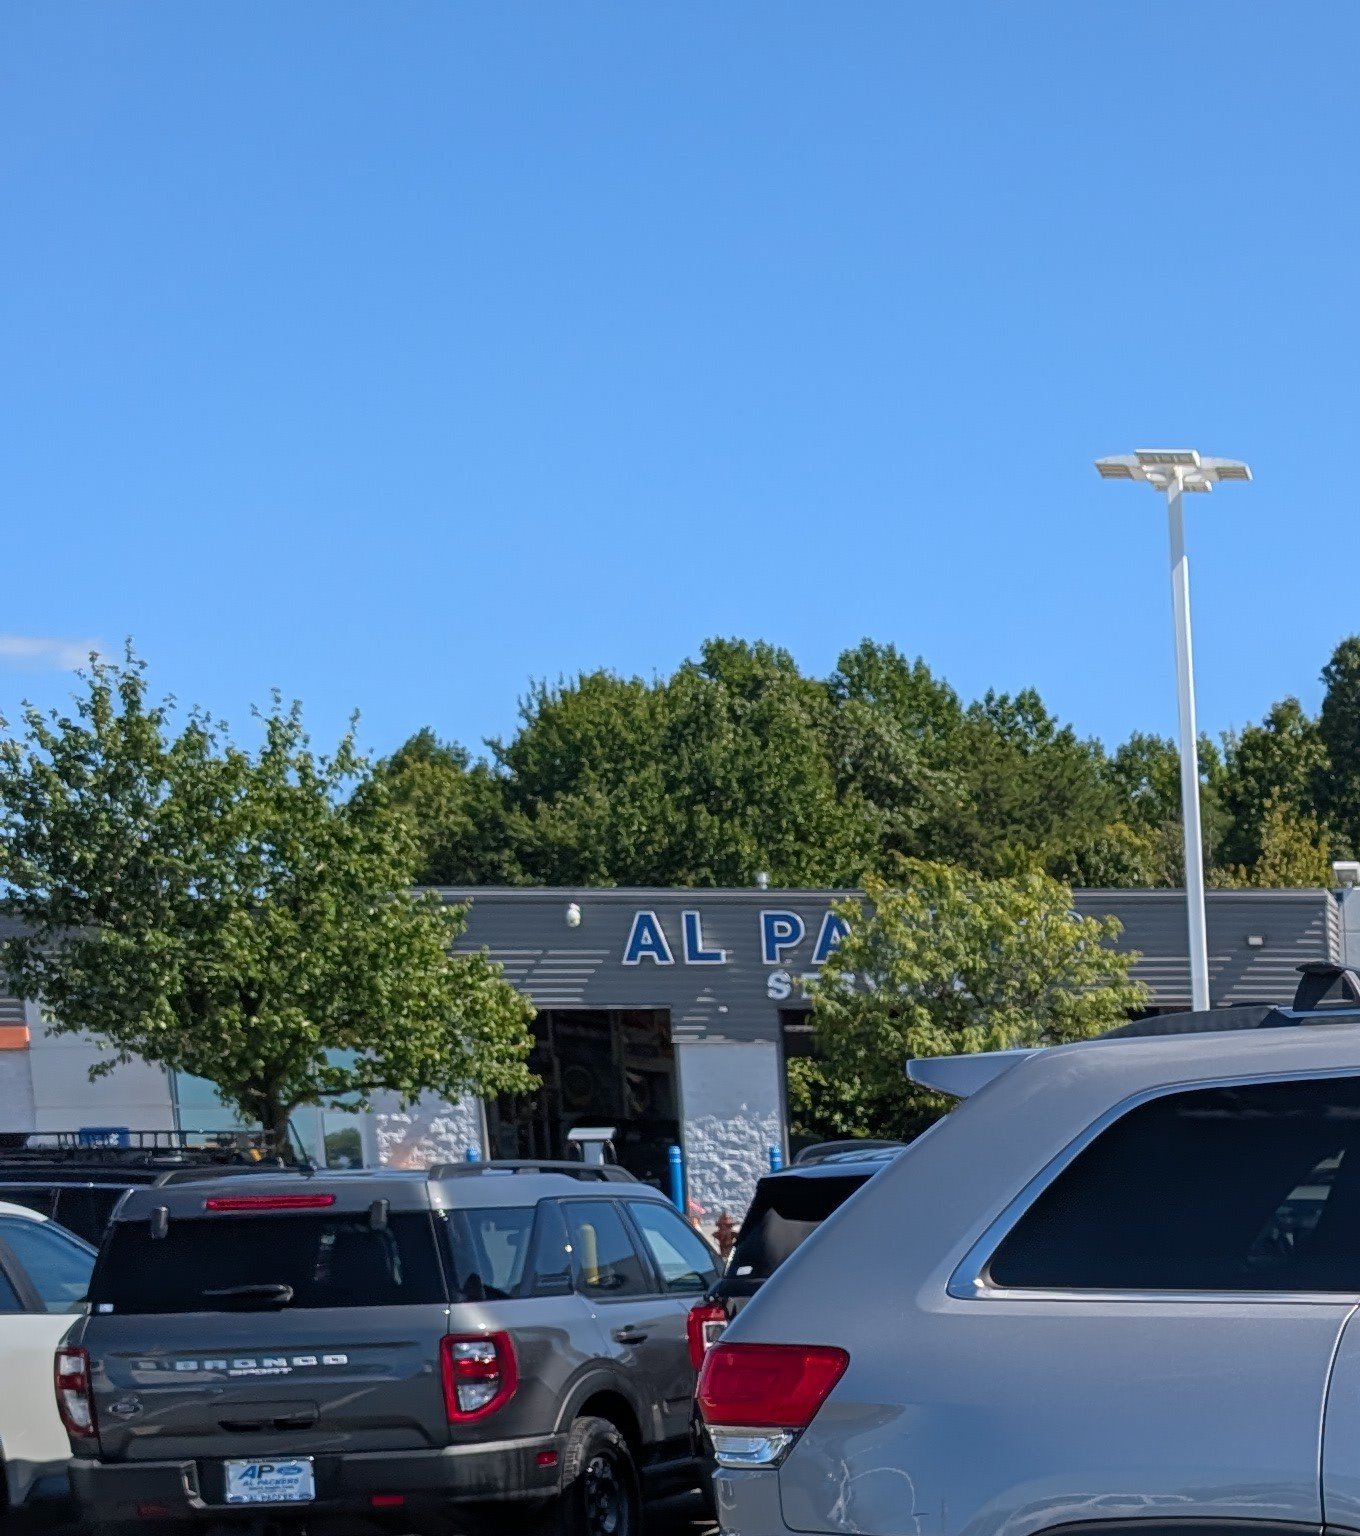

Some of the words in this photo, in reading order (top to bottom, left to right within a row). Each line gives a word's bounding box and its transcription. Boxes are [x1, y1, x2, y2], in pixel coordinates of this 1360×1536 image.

[622, 910, 727, 965] AL
[174, 1354, 348, 1371] BRONCO
[238, 1465, 275, 1479] AP
